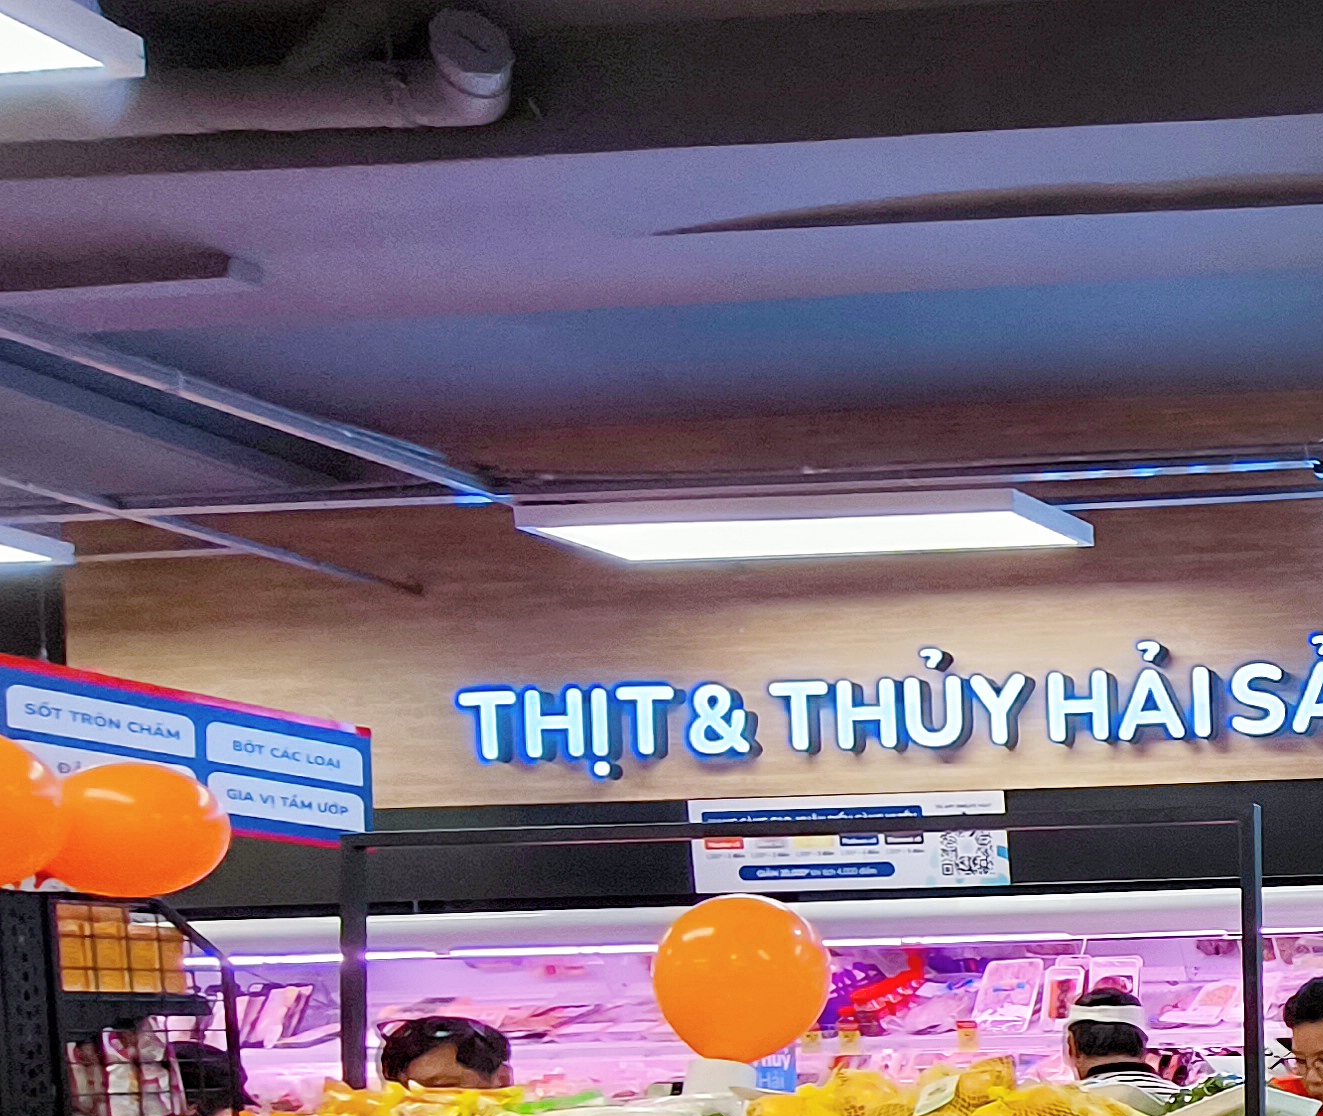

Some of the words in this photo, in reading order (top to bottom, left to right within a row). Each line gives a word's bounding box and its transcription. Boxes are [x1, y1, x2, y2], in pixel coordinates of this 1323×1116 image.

[456, 684, 676, 779] THỊT
[688, 682, 752, 757] &
[767, 646, 1028, 753] THỦY
[1046, 639, 1216, 745] HẢI
[226, 788, 254, 802] GIA
